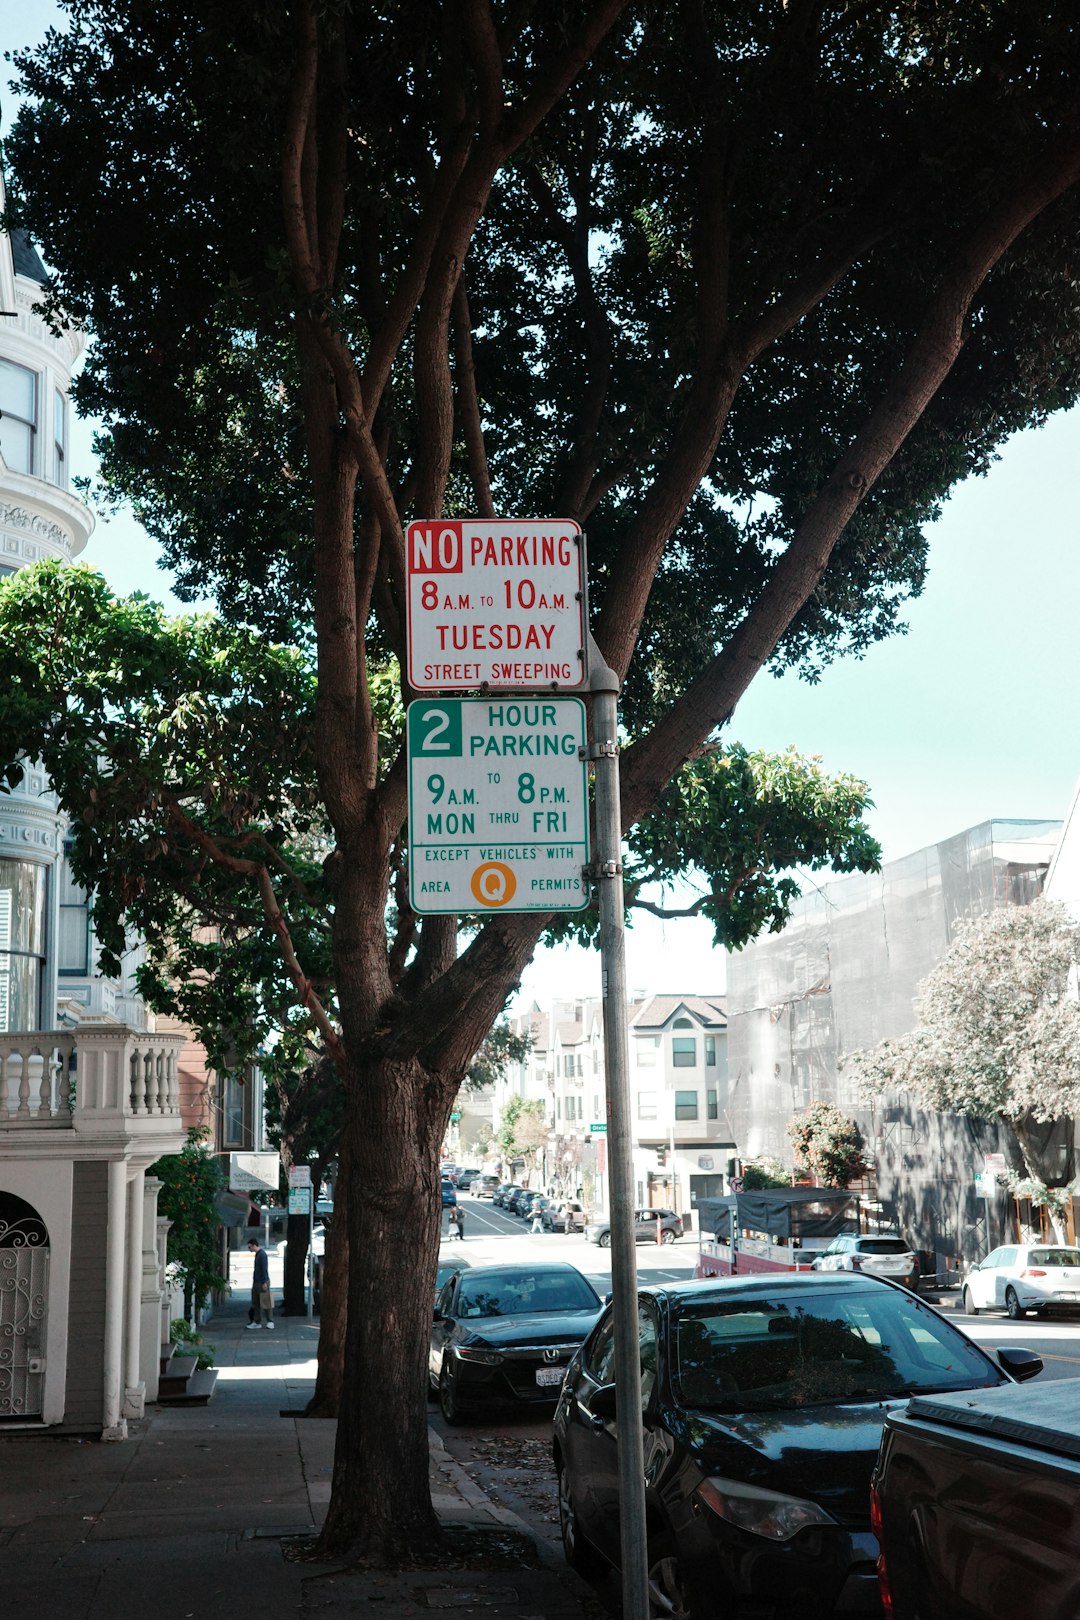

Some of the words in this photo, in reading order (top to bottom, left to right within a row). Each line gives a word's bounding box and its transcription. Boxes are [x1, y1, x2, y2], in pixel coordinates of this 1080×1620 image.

[414, 529, 459, 569] NO
[471, 536, 570, 566] PARKING
[480, 596, 494, 607] TO
[436, 624, 555, 650] TUESDAY
[424, 664, 481, 680] STREET
[491, 663, 571, 679] SWEEPING
[421, 709, 450, 750] 2
[488, 705, 557, 727] HOUR
[470, 734, 576, 757] PARKING
[487, 773, 501, 784] TO
[427, 813, 475, 835] MON
[489, 812, 519, 824] THRU
[533, 811, 567, 833] FRI
[425, 849, 469, 861] EXCEPT
[480, 848, 537, 860] VEHICLES
[546, 847, 574, 859] WITH
[421, 881, 451, 893] AREA
[479, 868, 506, 902] Q
[531, 878, 580, 890] PERMITS
